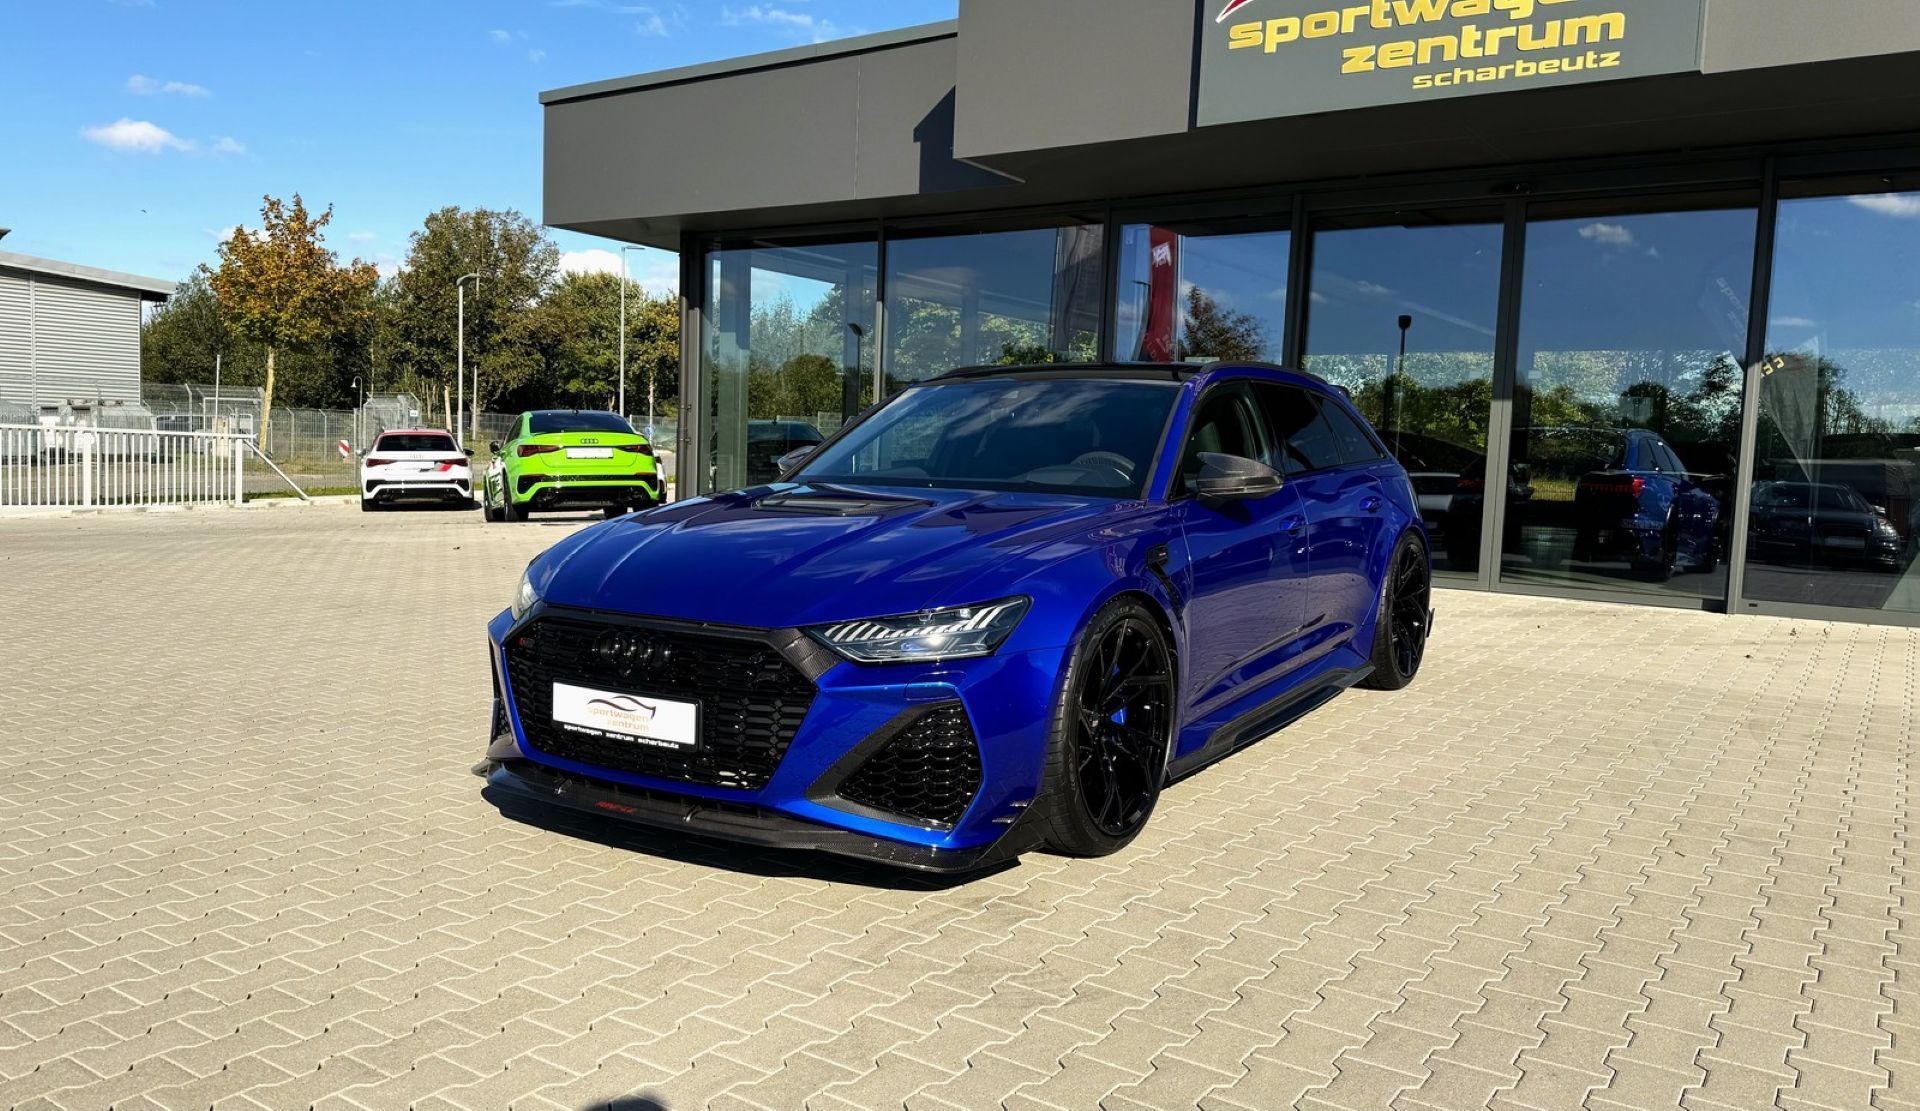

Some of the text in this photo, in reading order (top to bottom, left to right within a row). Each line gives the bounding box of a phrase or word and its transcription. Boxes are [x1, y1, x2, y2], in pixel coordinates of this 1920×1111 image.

[1228, 0, 1580, 53] sportwag
[1341, 12, 1625, 74] zentrum
[1412, 50, 1621, 89] scharbeutz
[587, 706, 650, 722] sportwagen
[608, 719, 650, 732] zentrum
[563, 724, 680, 749] sportwagen zentrum scharbeutz
